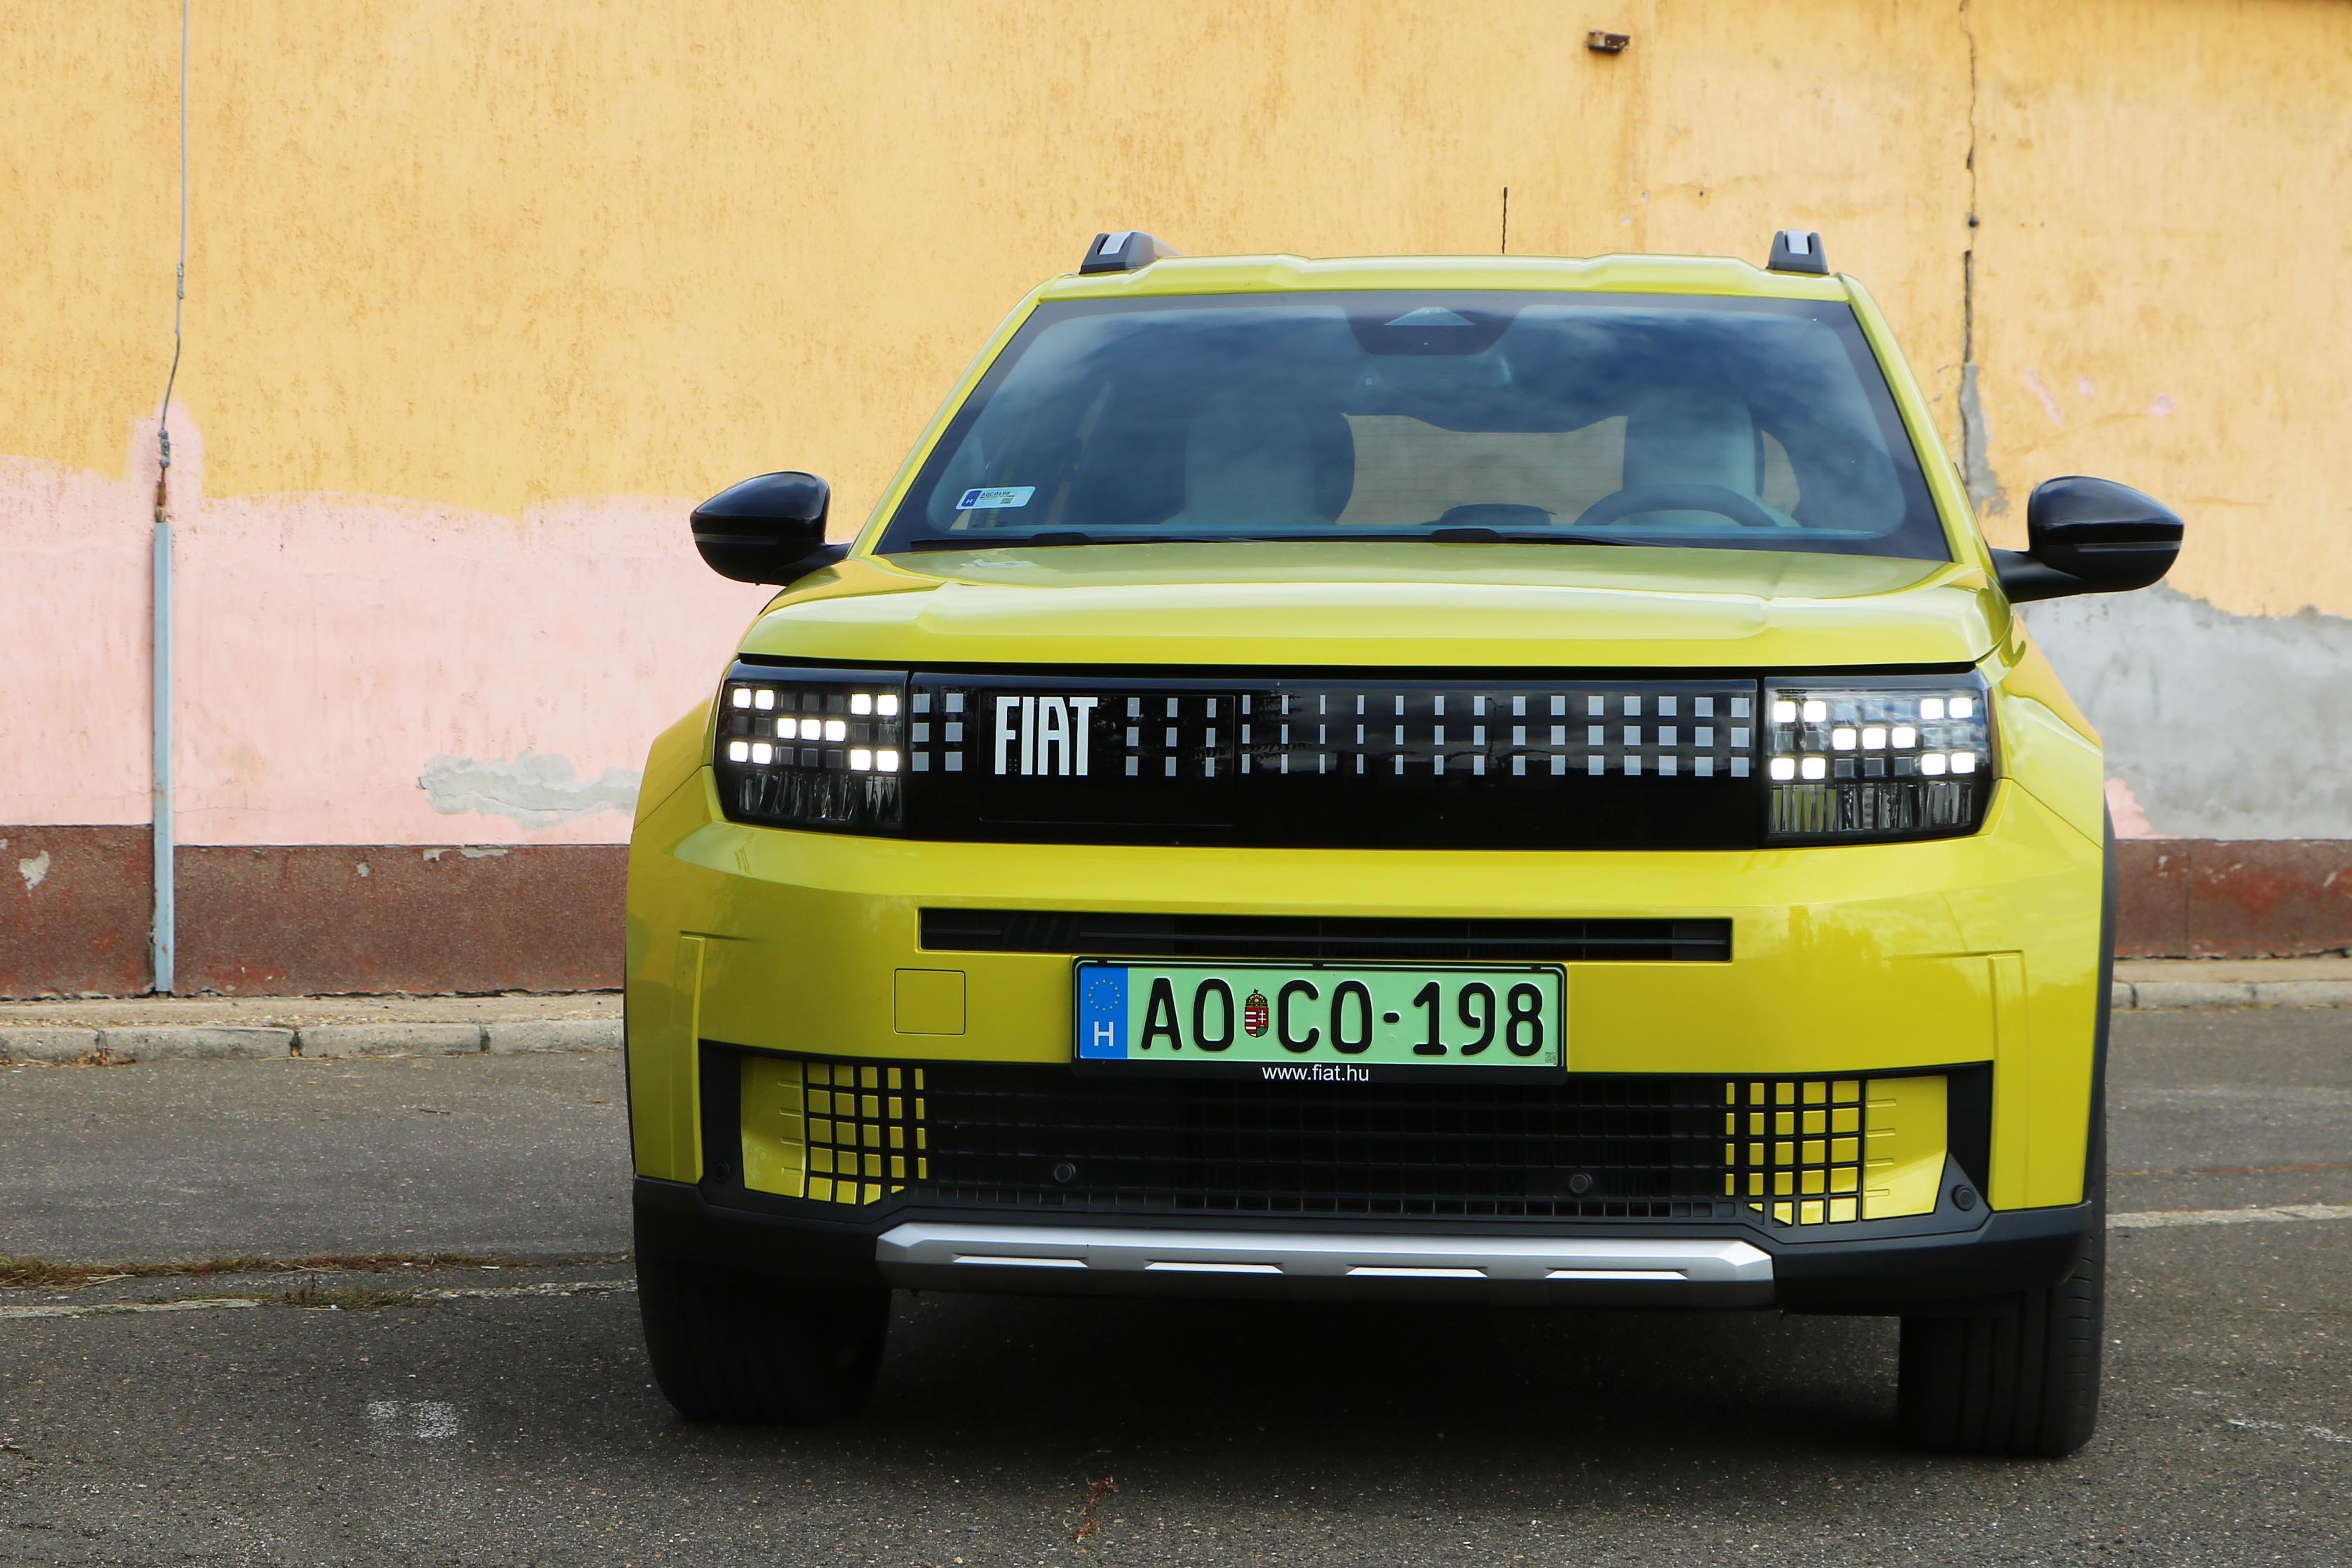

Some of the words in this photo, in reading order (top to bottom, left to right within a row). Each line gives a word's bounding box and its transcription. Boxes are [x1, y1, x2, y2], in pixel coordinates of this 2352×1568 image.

[994, 696, 1098, 776] FIAT
[1094, 1021, 1114, 1047] H
[1262, 1064, 1370, 1081] www.fiat.hu
